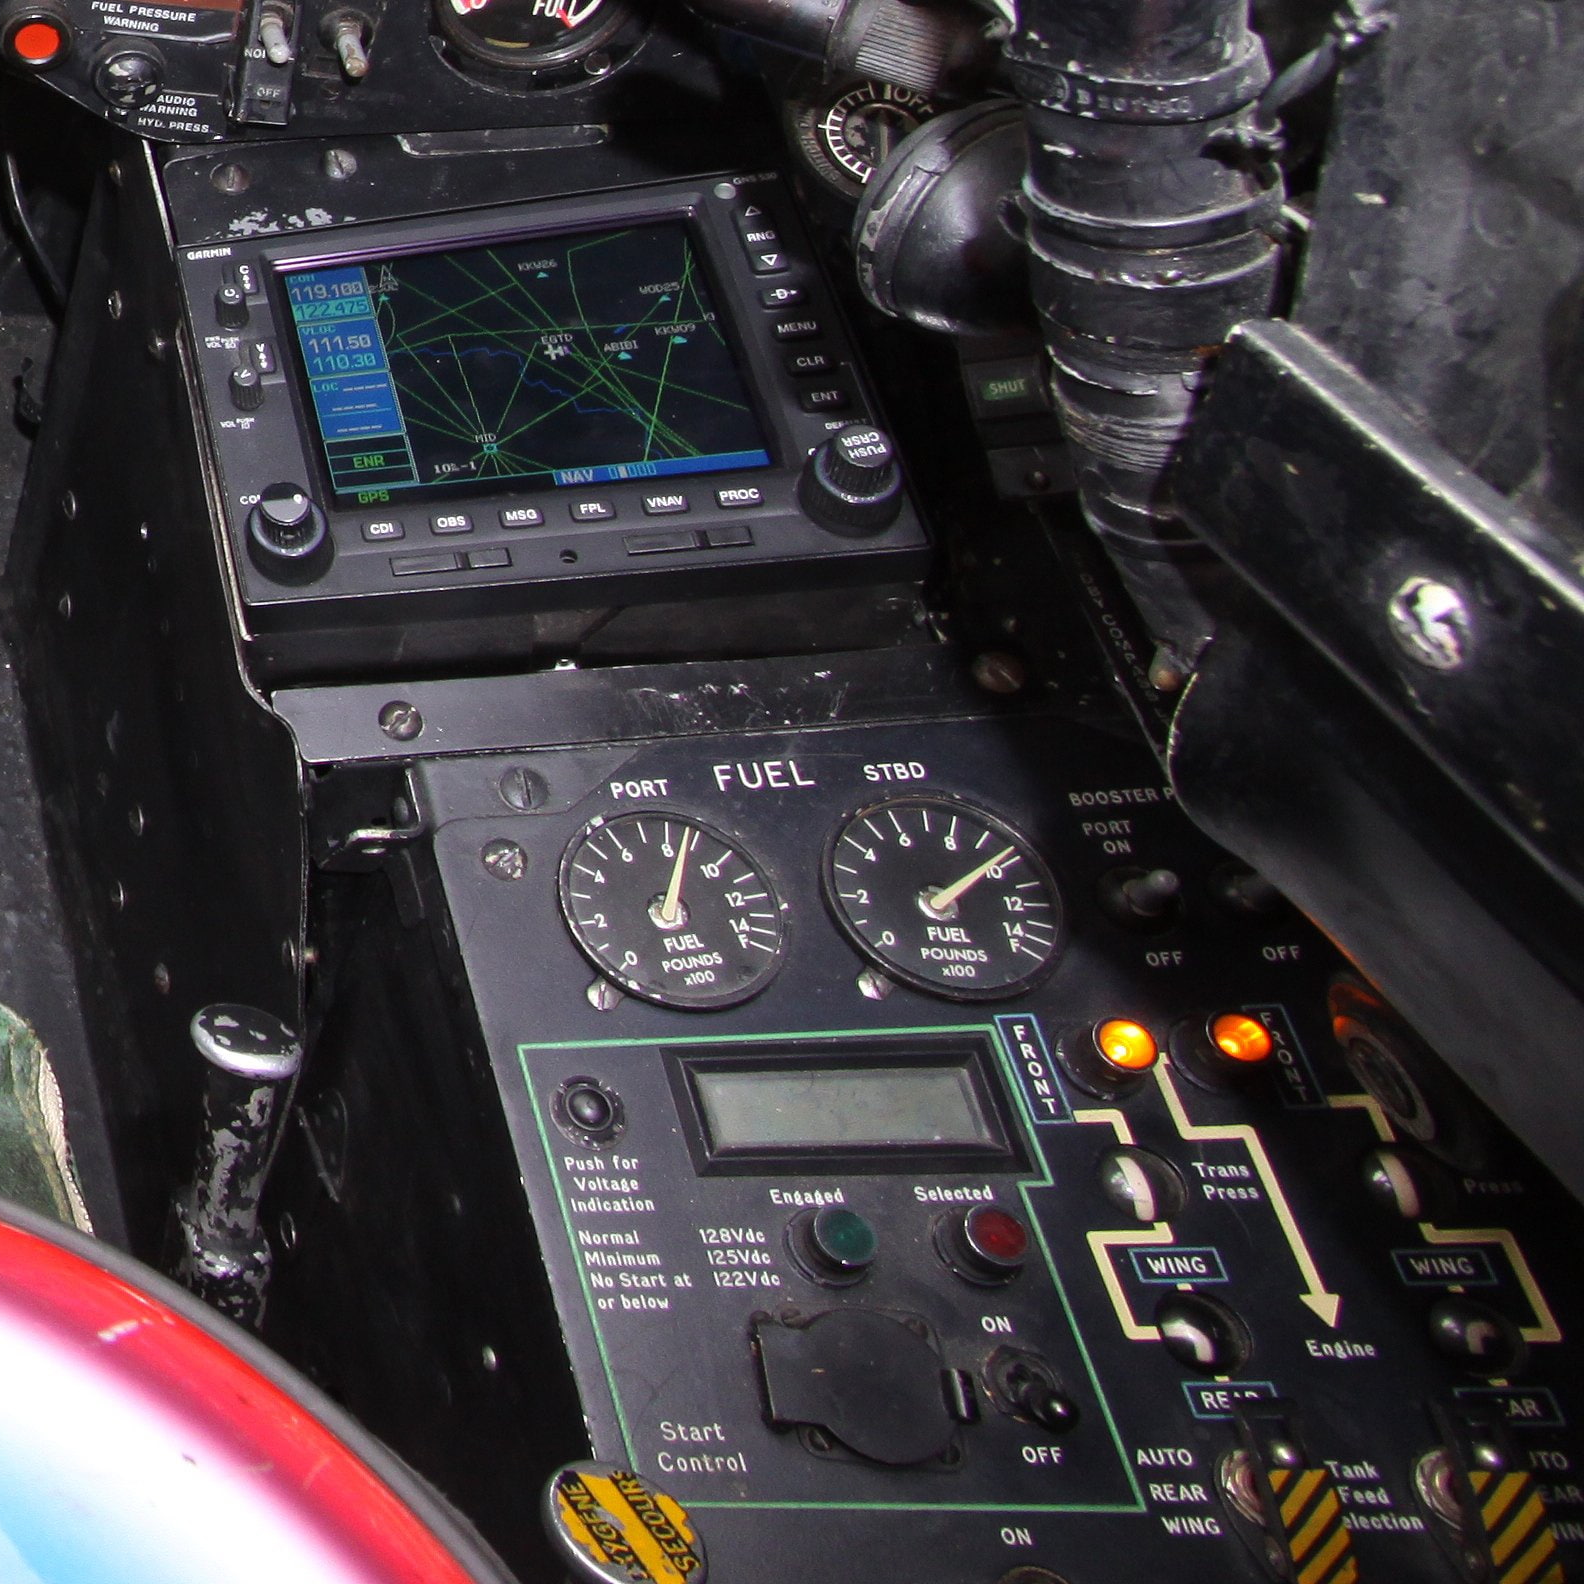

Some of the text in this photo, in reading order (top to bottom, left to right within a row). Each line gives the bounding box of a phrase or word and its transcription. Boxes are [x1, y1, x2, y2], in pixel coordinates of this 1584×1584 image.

[90, 1, 196, 23] FUEL PRESSURE
[103, 15, 160, 32] WARNING
[156, 94, 196, 107] AUDIO
[186, 247, 232, 262] GARMIN
[776, 320, 817, 334] MENU
[795, 355, 825, 368] CLR
[646, 494, 683, 509] VNAV
[719, 487, 760, 503] PROC
[505, 508, 538, 522] MSG
[579, 502, 606, 516] FPL
[369, 521, 394, 537] CDI
[436, 515, 466, 529] OBS
[712, 760, 815, 793] FUEL
[862, 760, 927, 783] STBD
[610, 777, 669, 801] PORT
[1069, 787, 1160, 808] BOOSTER
[1082, 820, 1133, 837] PORT
[927, 926, 972, 945] FUEL
[661, 951, 723, 975] POUNDS
[920, 945, 988, 964] POUNDS
[1145, 951, 1184, 969] OFF
[563, 1155, 640, 1172] Push for
[1191, 1161, 1250, 1179] Trans
[572, 1176, 640, 1194] Voltage
[913, 1184, 994, 1203] Selected
[1202, 1184, 1260, 1202] Press
[569, 1196, 656, 1214] Indication
[769, 1187, 845, 1208] Engaged
[578, 1228, 767, 1246] Normal 128Vdc
[705, 1249, 772, 1266] 125Vdc
[1146, 1255, 1208, 1276] WING
[590, 1270, 782, 1289] No Start at 122Vdc
[620, 1293, 671, 1311] below
[1306, 1339, 1378, 1359] Engine
[660, 1420, 726, 1443] Start
[657, 1450, 748, 1475] Control
[1136, 1448, 1194, 1468] AUTO
[1325, 1460, 1380, 1480] Tank
[1149, 1483, 1209, 1503] REAR
[1337, 1486, 1392, 1507] Feed
[1161, 1516, 1223, 1536] WING
